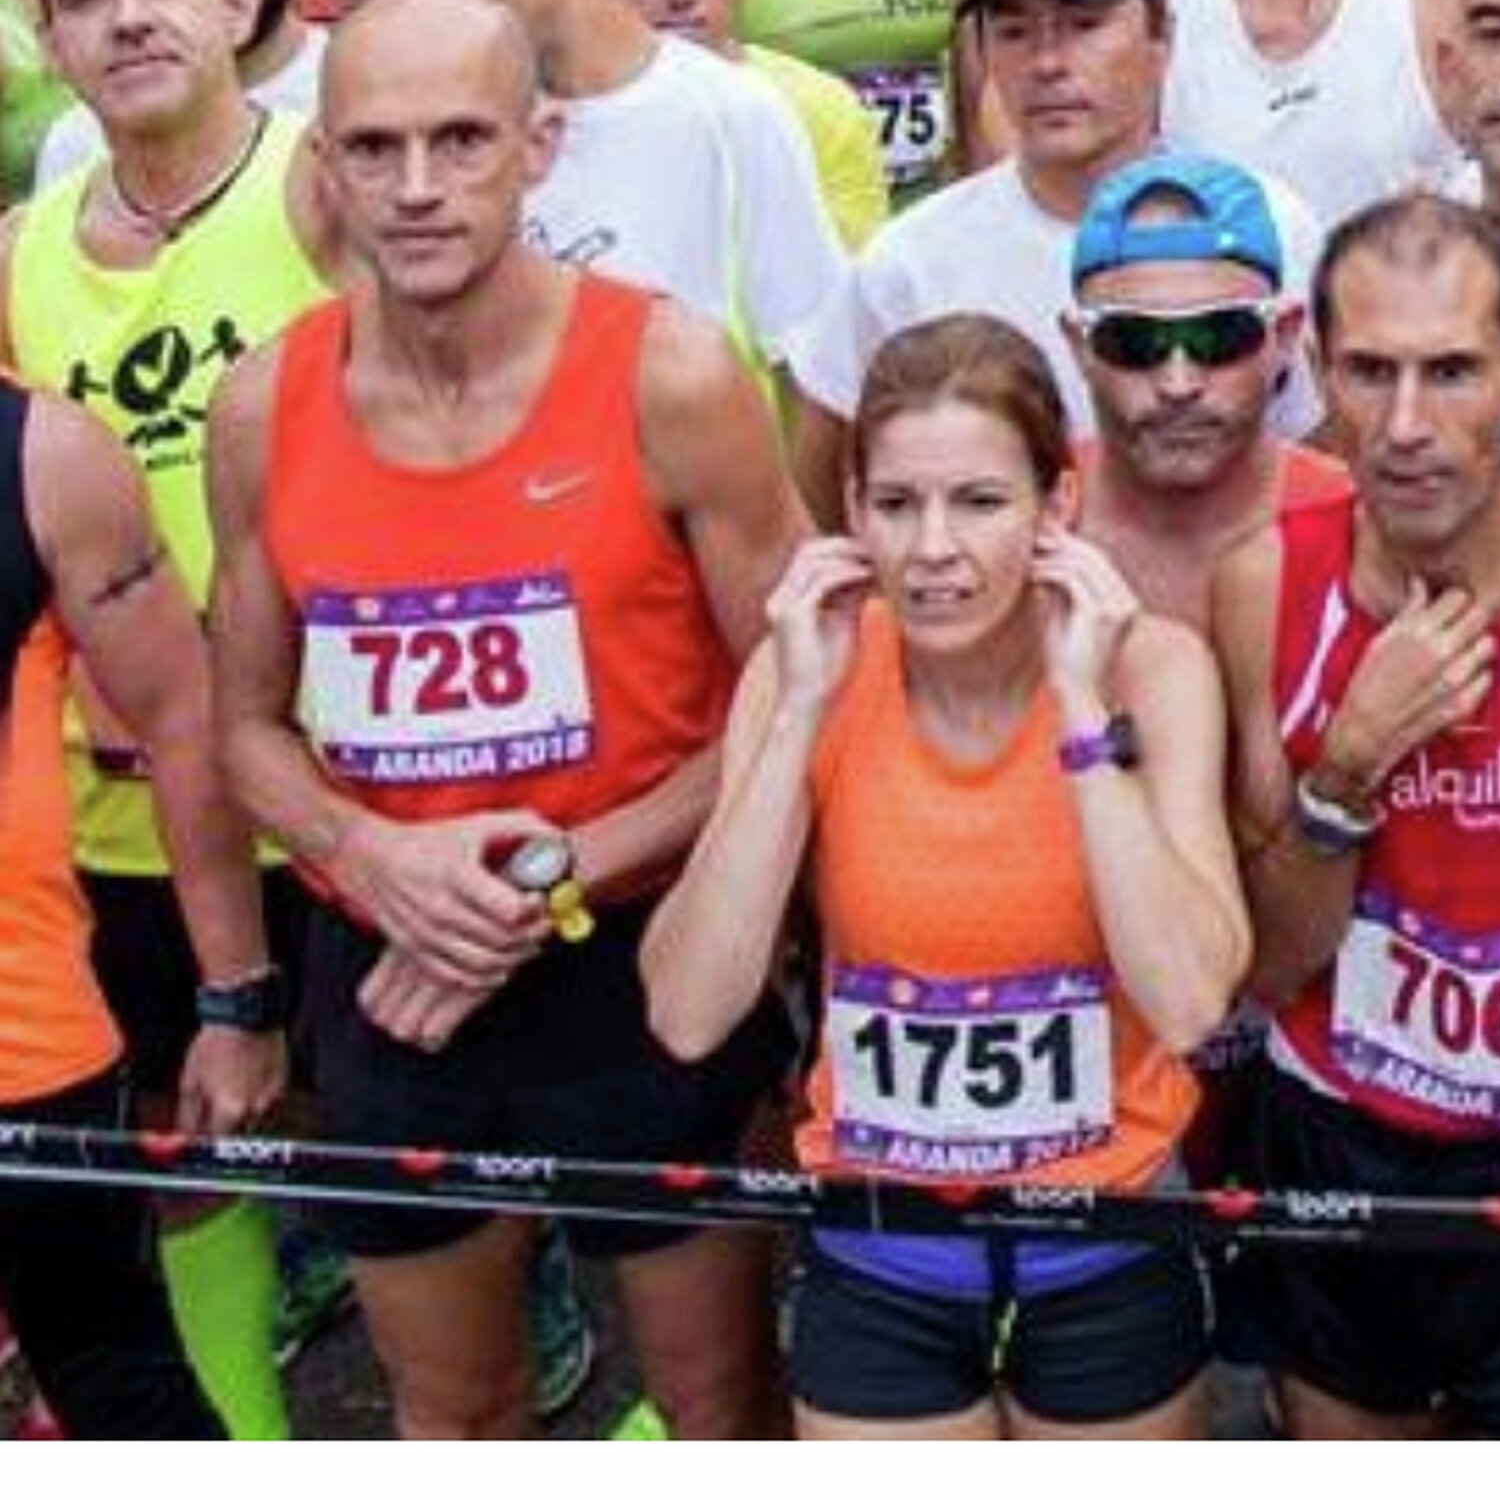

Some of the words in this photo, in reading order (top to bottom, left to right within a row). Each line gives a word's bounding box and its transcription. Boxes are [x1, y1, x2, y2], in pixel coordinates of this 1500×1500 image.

[350, 623, 530, 716] 728
[371, 743, 498, 785] ARANDA
[854, 1012, 1075, 1110] 1751
[886, 1132, 1012, 1174] ARANDA
